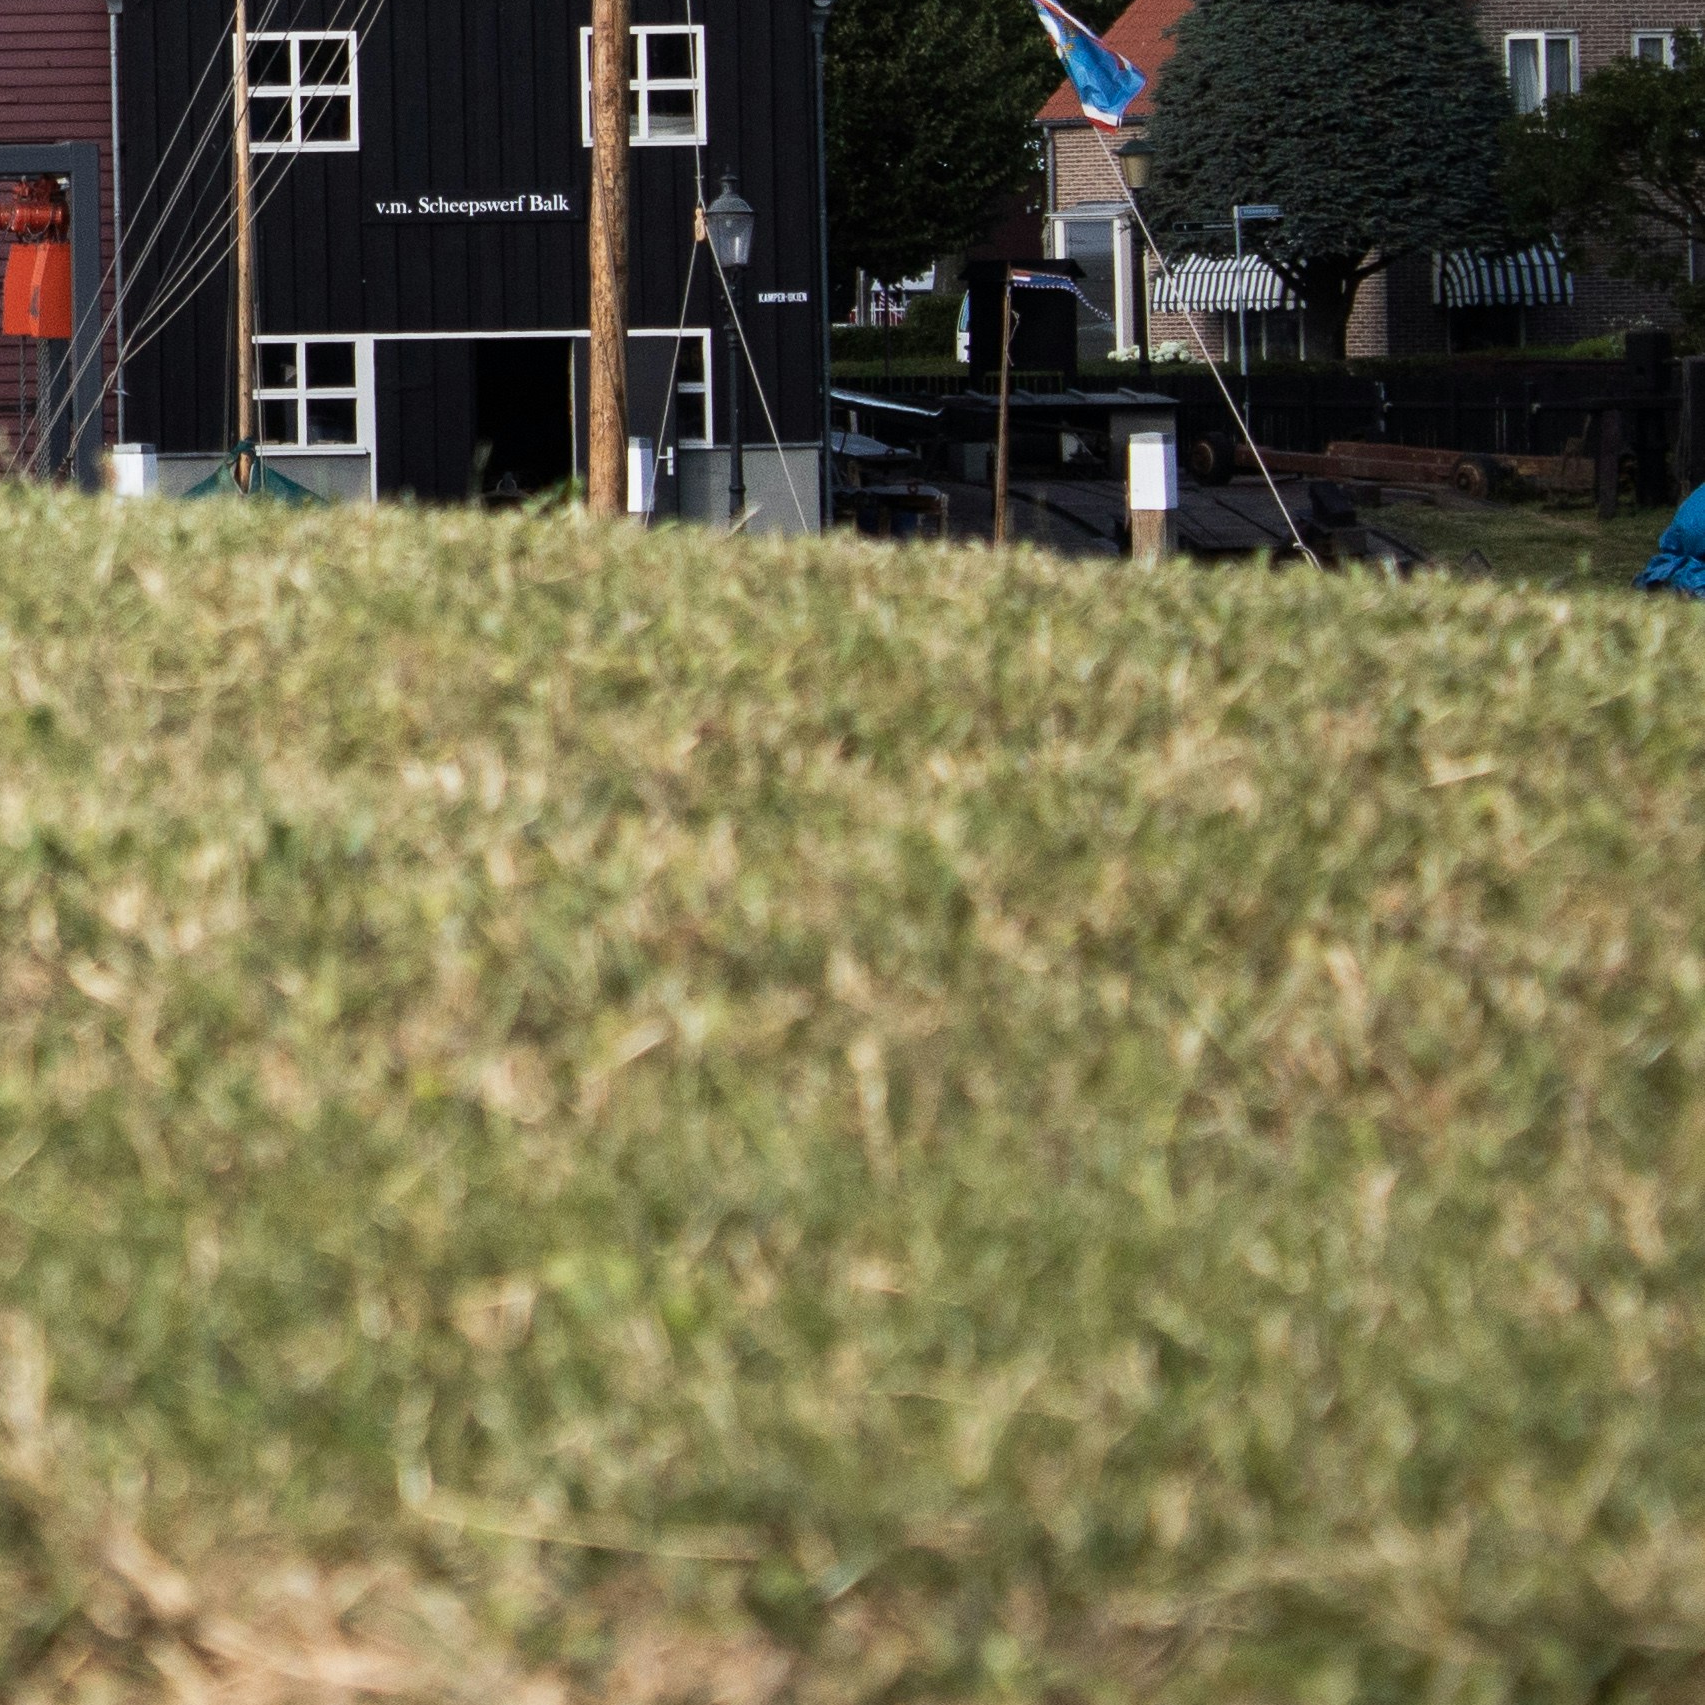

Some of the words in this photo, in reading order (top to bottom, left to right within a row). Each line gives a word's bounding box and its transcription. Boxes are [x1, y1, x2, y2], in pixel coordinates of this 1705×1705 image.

[375, 202, 412, 214] v.m.
[418, 195, 526, 217] Scheepswerf
[529, 194, 570, 212] Balk
